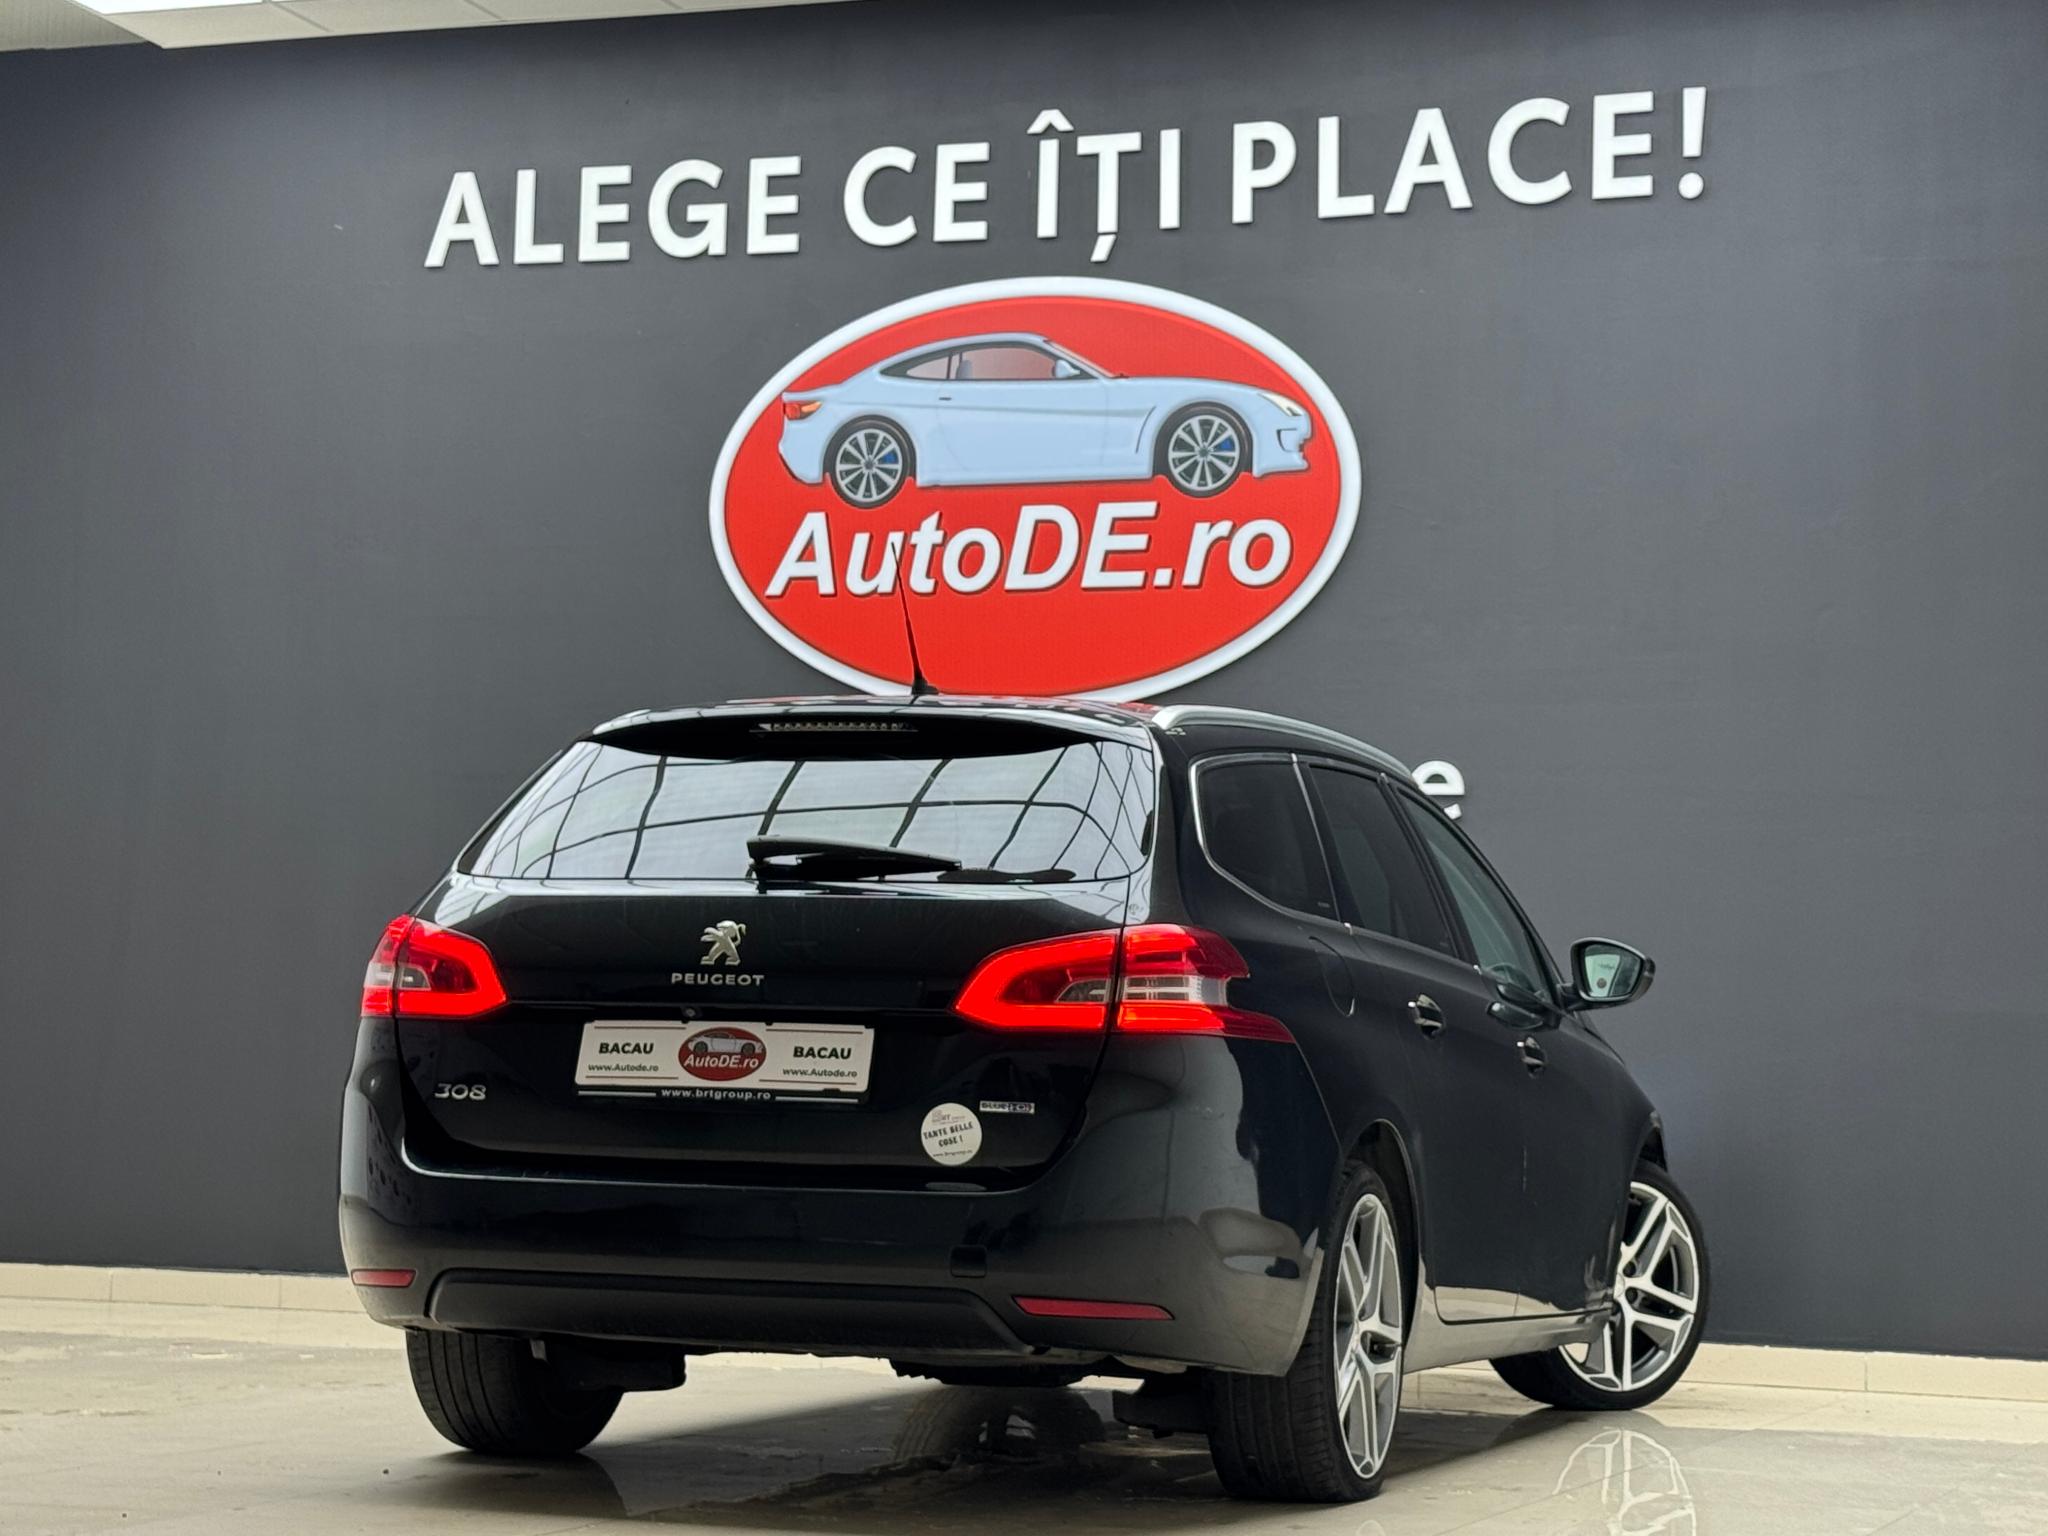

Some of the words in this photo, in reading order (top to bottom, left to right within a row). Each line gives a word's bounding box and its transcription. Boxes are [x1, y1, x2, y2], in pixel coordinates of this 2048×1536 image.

[424, 155, 801, 268] ALEGE
[843, 141, 990, 247] CE
[1231, 86, 1707, 224] PLACE!
[764, 500, 1293, 599] AutoDE.ro
[671, 972, 765, 986] PEUGEOT
[598, 1042, 654, 1055] BACAU
[793, 1046, 852, 1060] BACAU
[588, 1063, 659, 1073] www.Autode.ro
[683, 1053, 760, 1069] AutoDE.ro
[782, 1068, 858, 1079] www.Autode.ro
[434, 1083, 487, 1100] 308
[661, 1088, 772, 1101] www.brtgroup.ro
